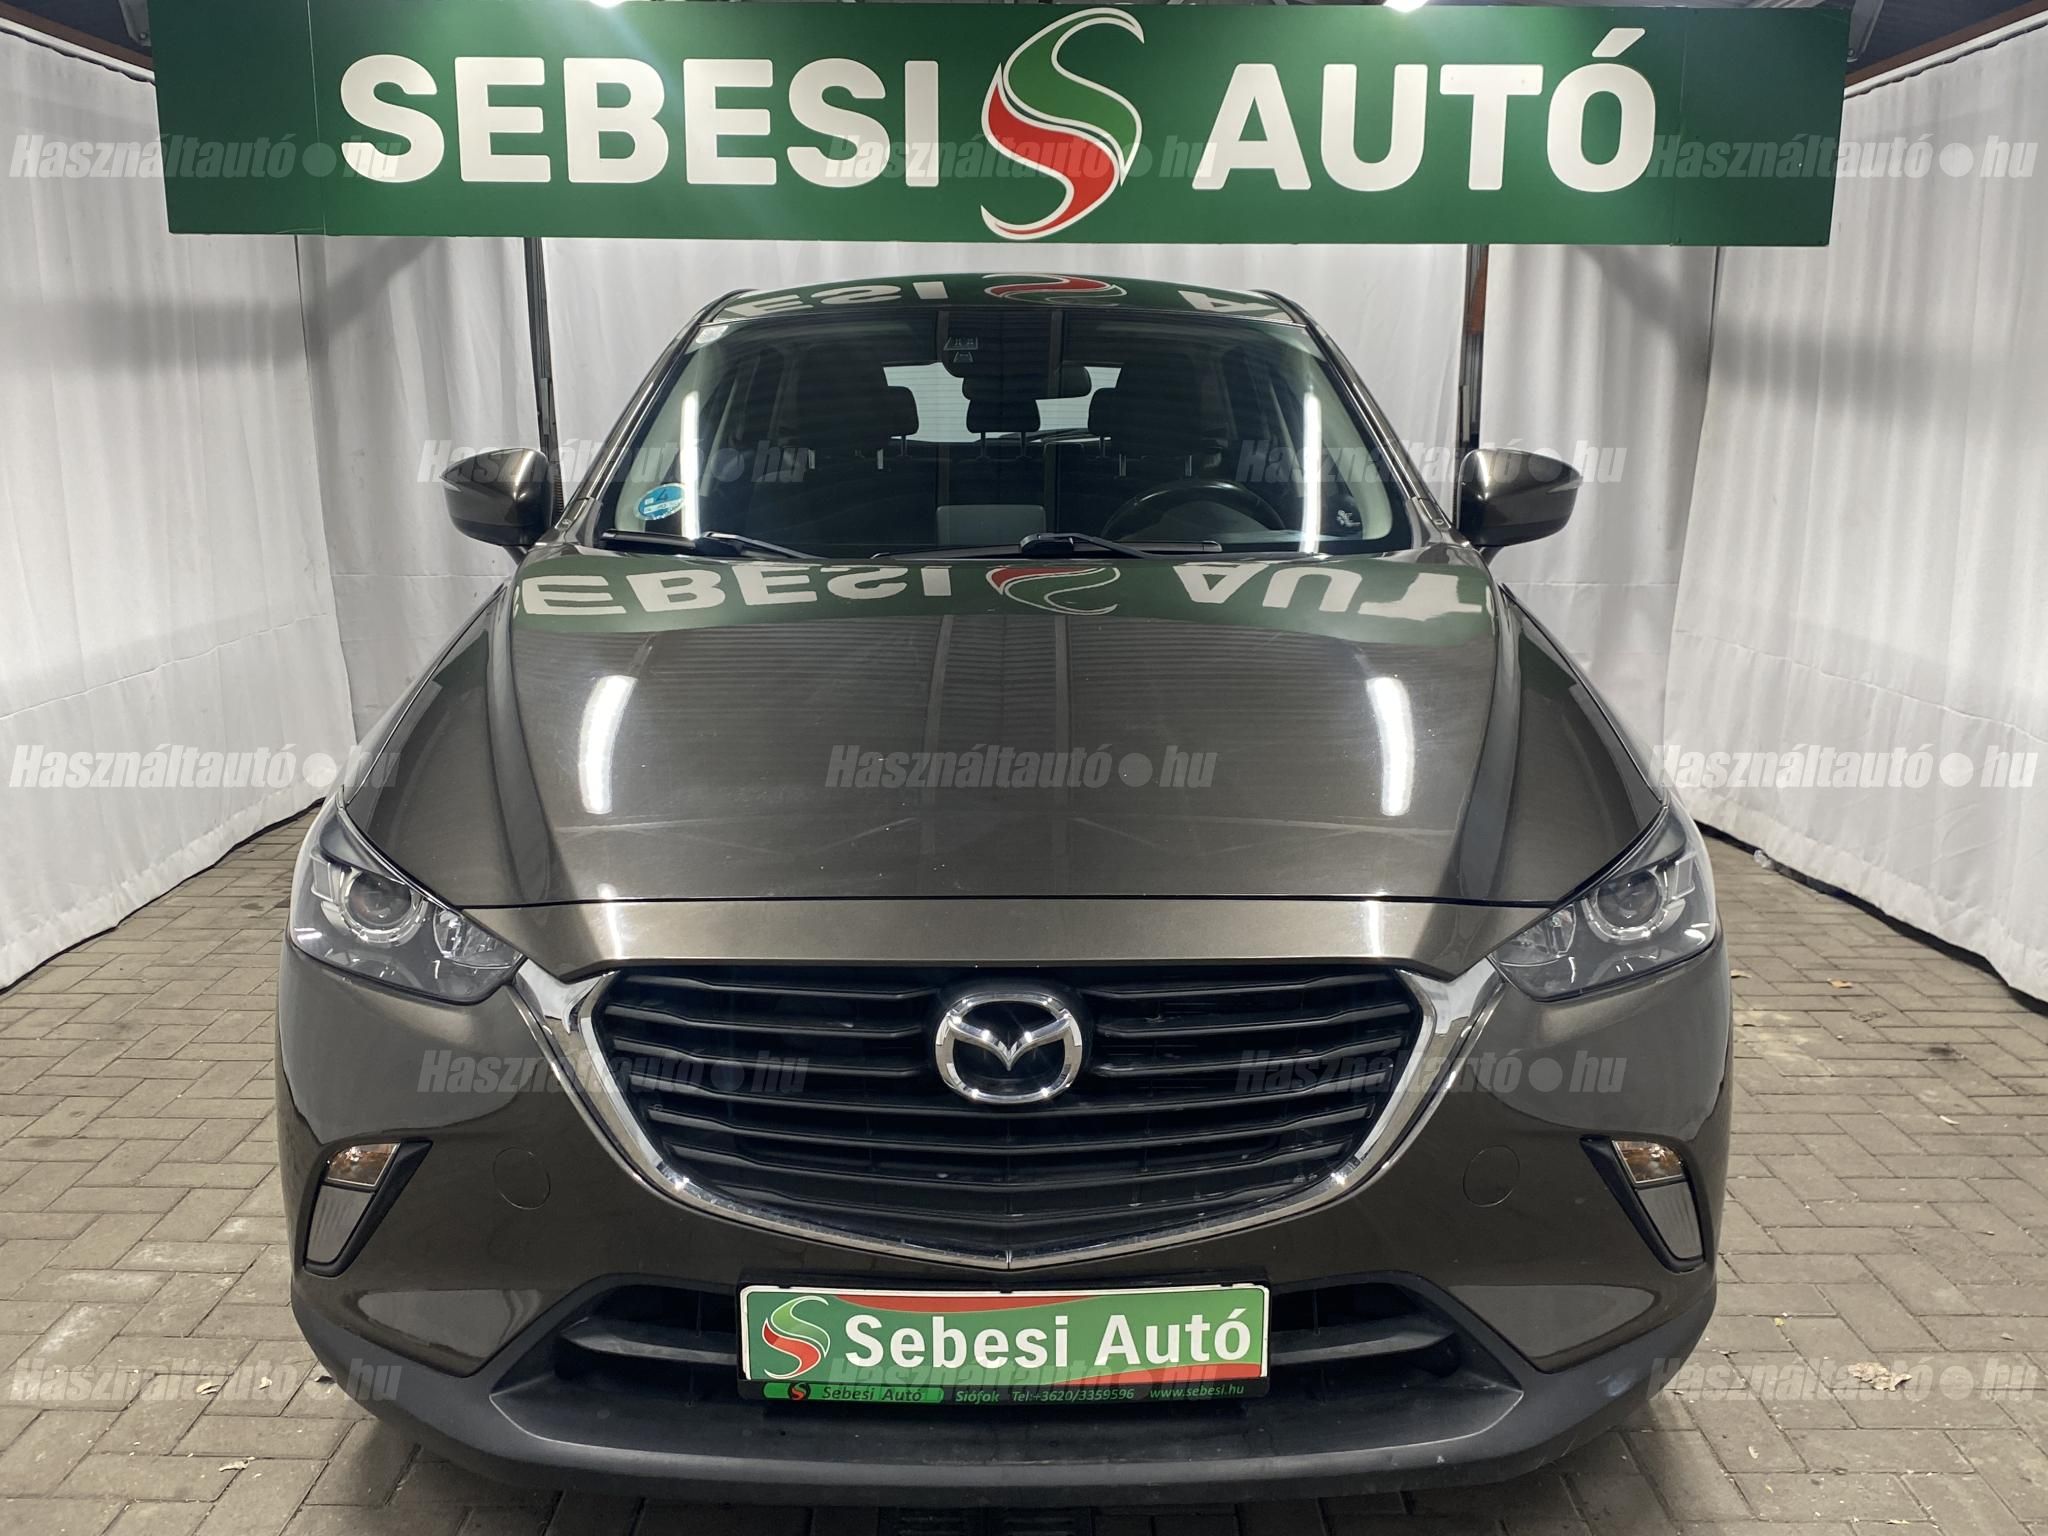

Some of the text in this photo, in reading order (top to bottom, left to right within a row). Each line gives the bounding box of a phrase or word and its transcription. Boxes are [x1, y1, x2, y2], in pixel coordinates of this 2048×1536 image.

[340, 53, 939, 188] SEBESI
[1192, 28, 1655, 193] AUTÓ
[845, 1314, 1068, 1369] Sebesi
[1094, 1307, 1250, 1367] Autó
[823, 1386, 874, 1400] Sebesi
[881, 1386, 923, 1401] Autó
[956, 1389, 1000, 1405] Siófok
[1150, 1384, 1245, 1399] www.sebesi.hu
